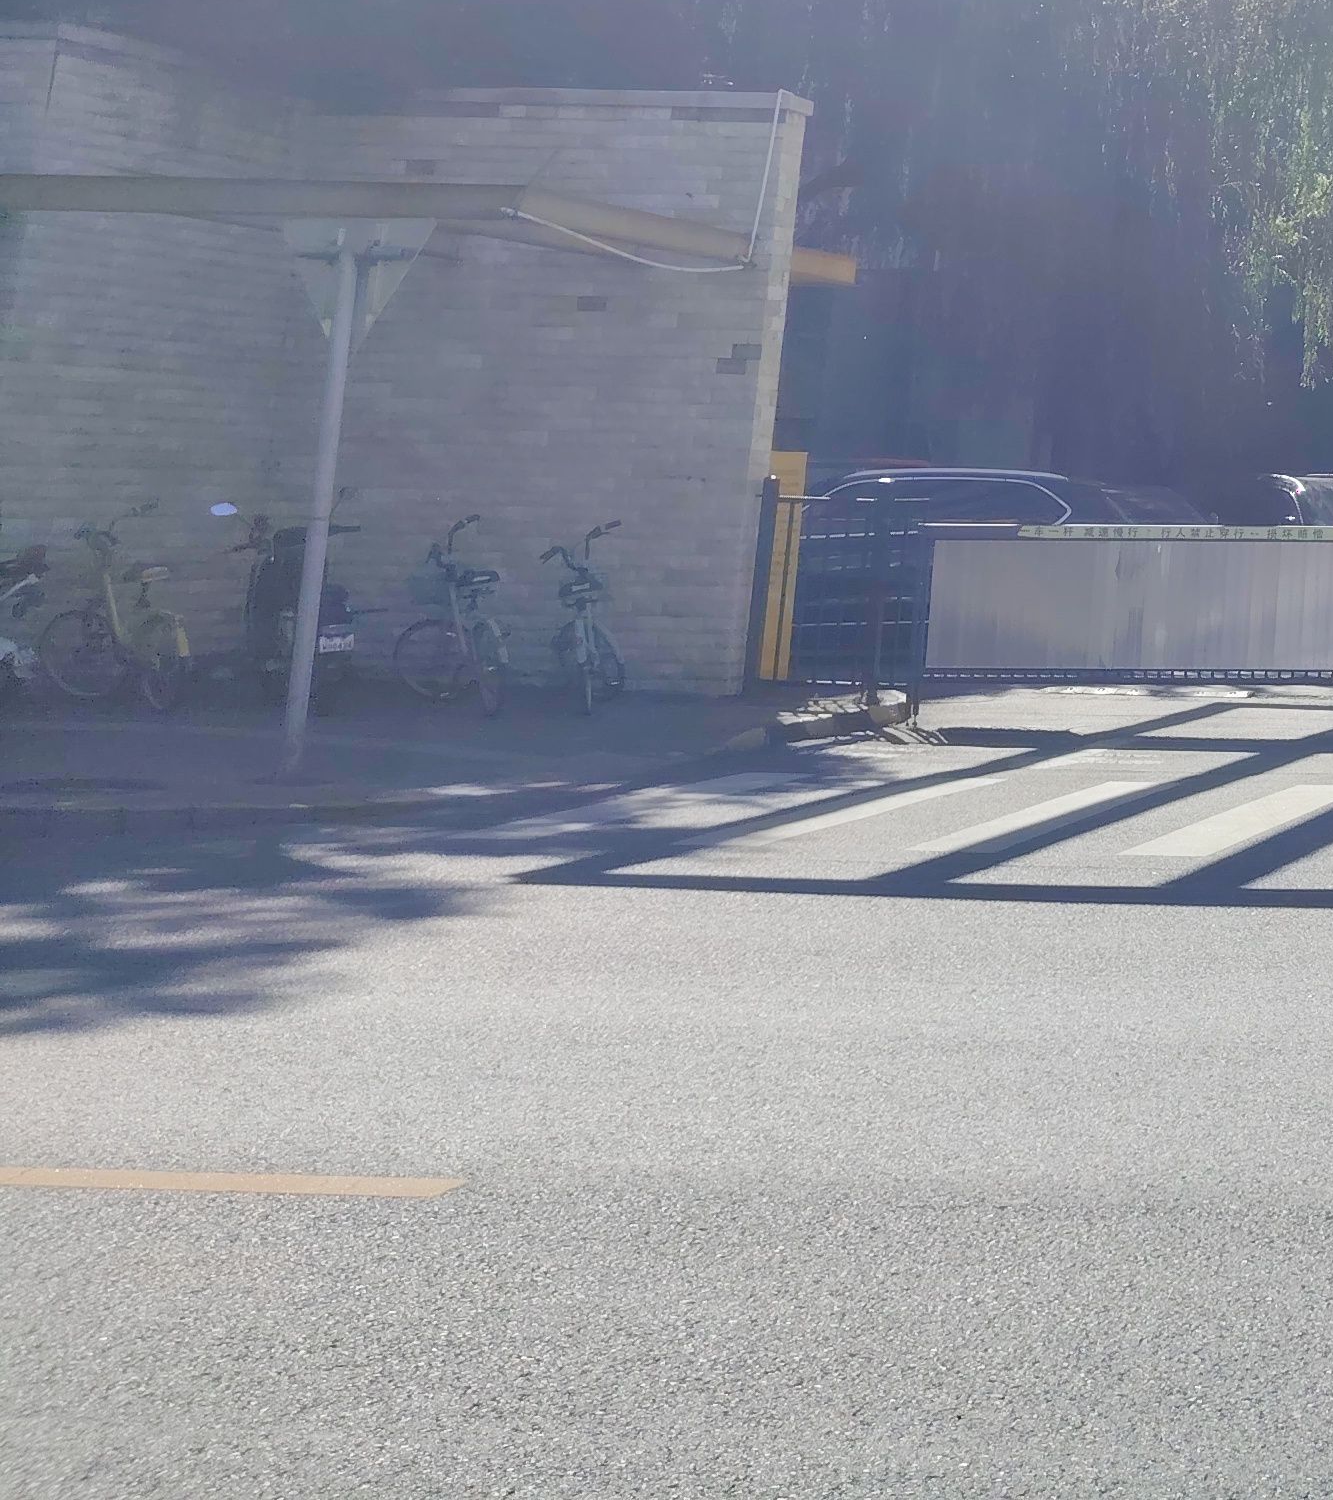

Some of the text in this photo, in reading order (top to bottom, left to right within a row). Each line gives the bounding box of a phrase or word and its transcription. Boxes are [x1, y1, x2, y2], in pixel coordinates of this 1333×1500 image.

[1084, 526, 1138, 538] 减速慢行
[1161, 527, 1245, 539] 行人禁止穿行
